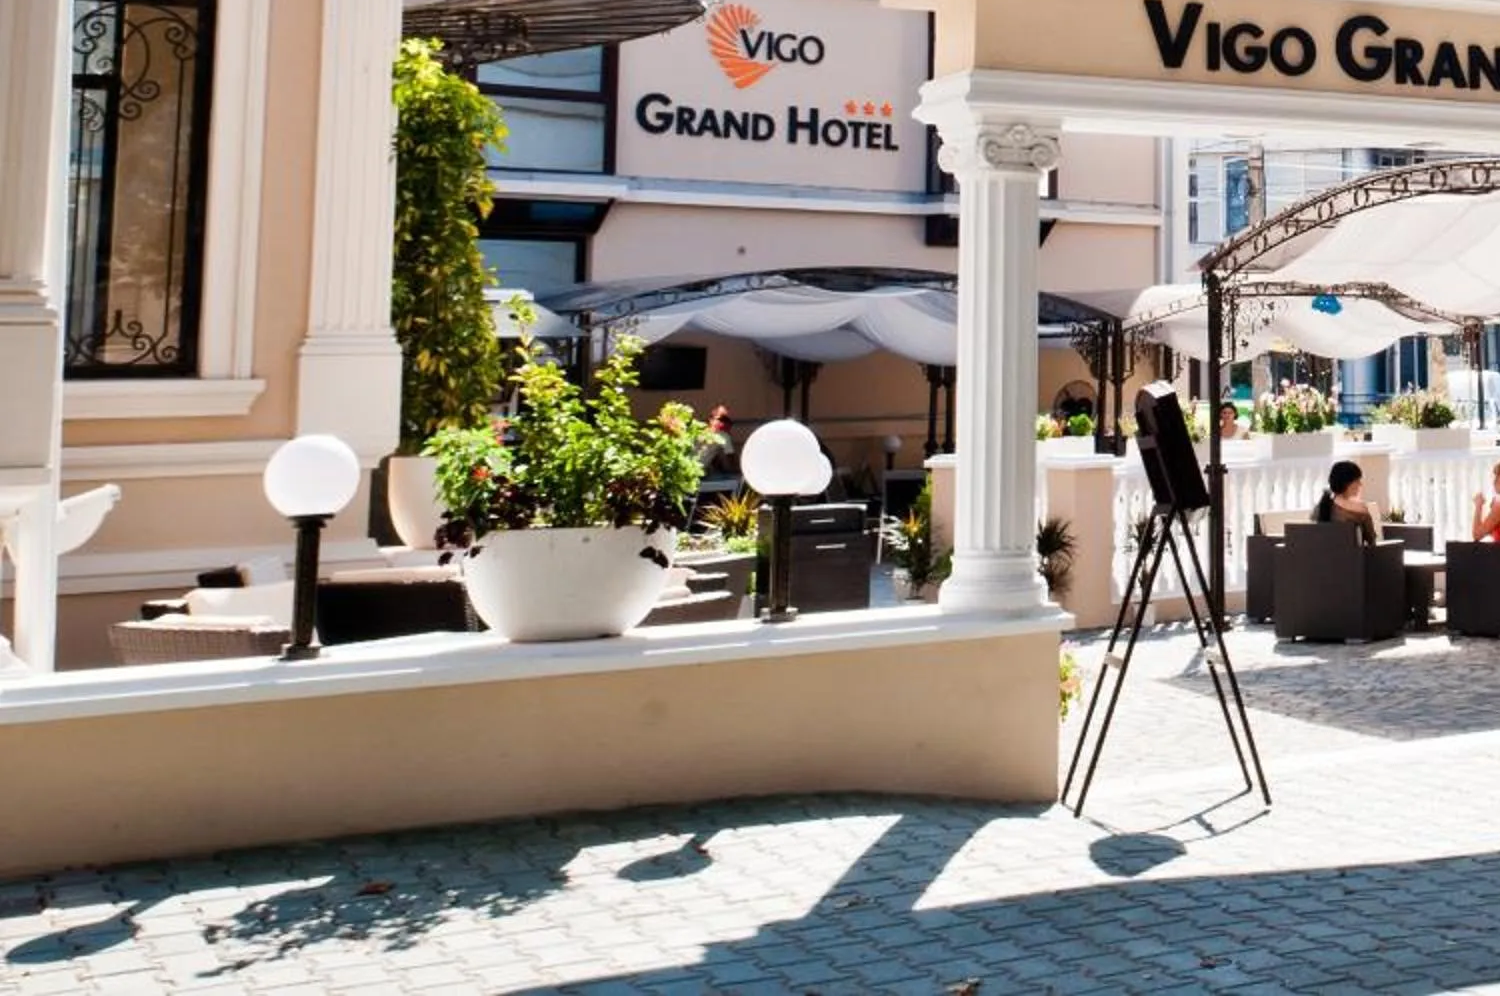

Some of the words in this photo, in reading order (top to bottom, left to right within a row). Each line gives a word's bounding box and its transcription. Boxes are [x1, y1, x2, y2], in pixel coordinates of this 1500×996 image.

[740, 28, 825, 66] VIGO
[635, 92, 775, 142] GRAND
[787, 105, 900, 152] HOTEL
